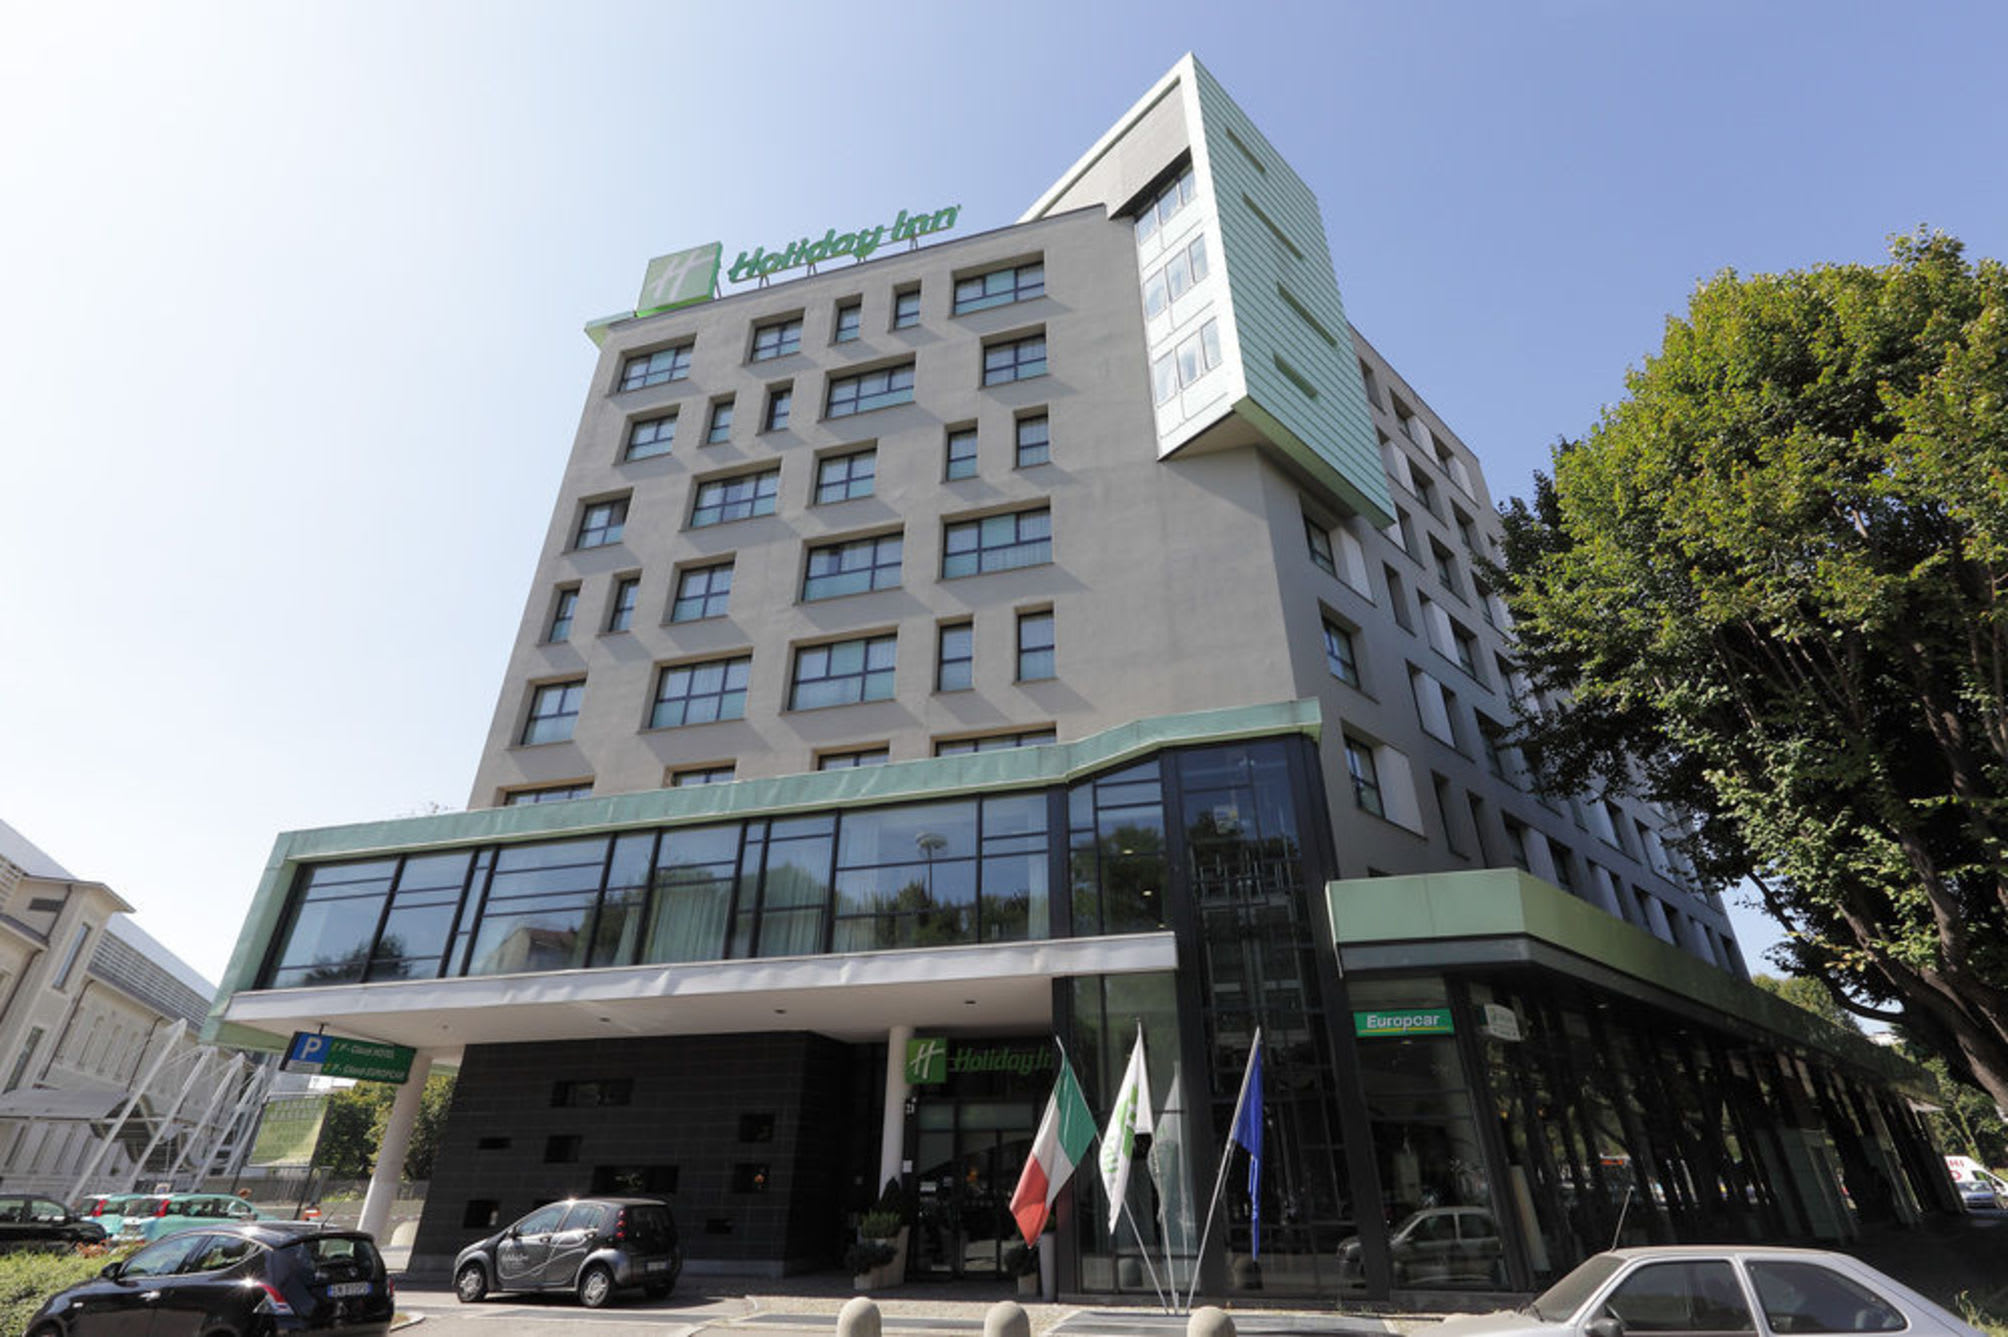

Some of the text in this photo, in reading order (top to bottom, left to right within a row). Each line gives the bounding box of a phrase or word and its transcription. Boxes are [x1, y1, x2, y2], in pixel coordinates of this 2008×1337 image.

[728, 208, 958, 283] Holiday Inn
[1367, 1014, 1440, 1031] Europcar
[301, 1036, 323, 1060] P
[953, 1048, 1034, 1075] Holiday
